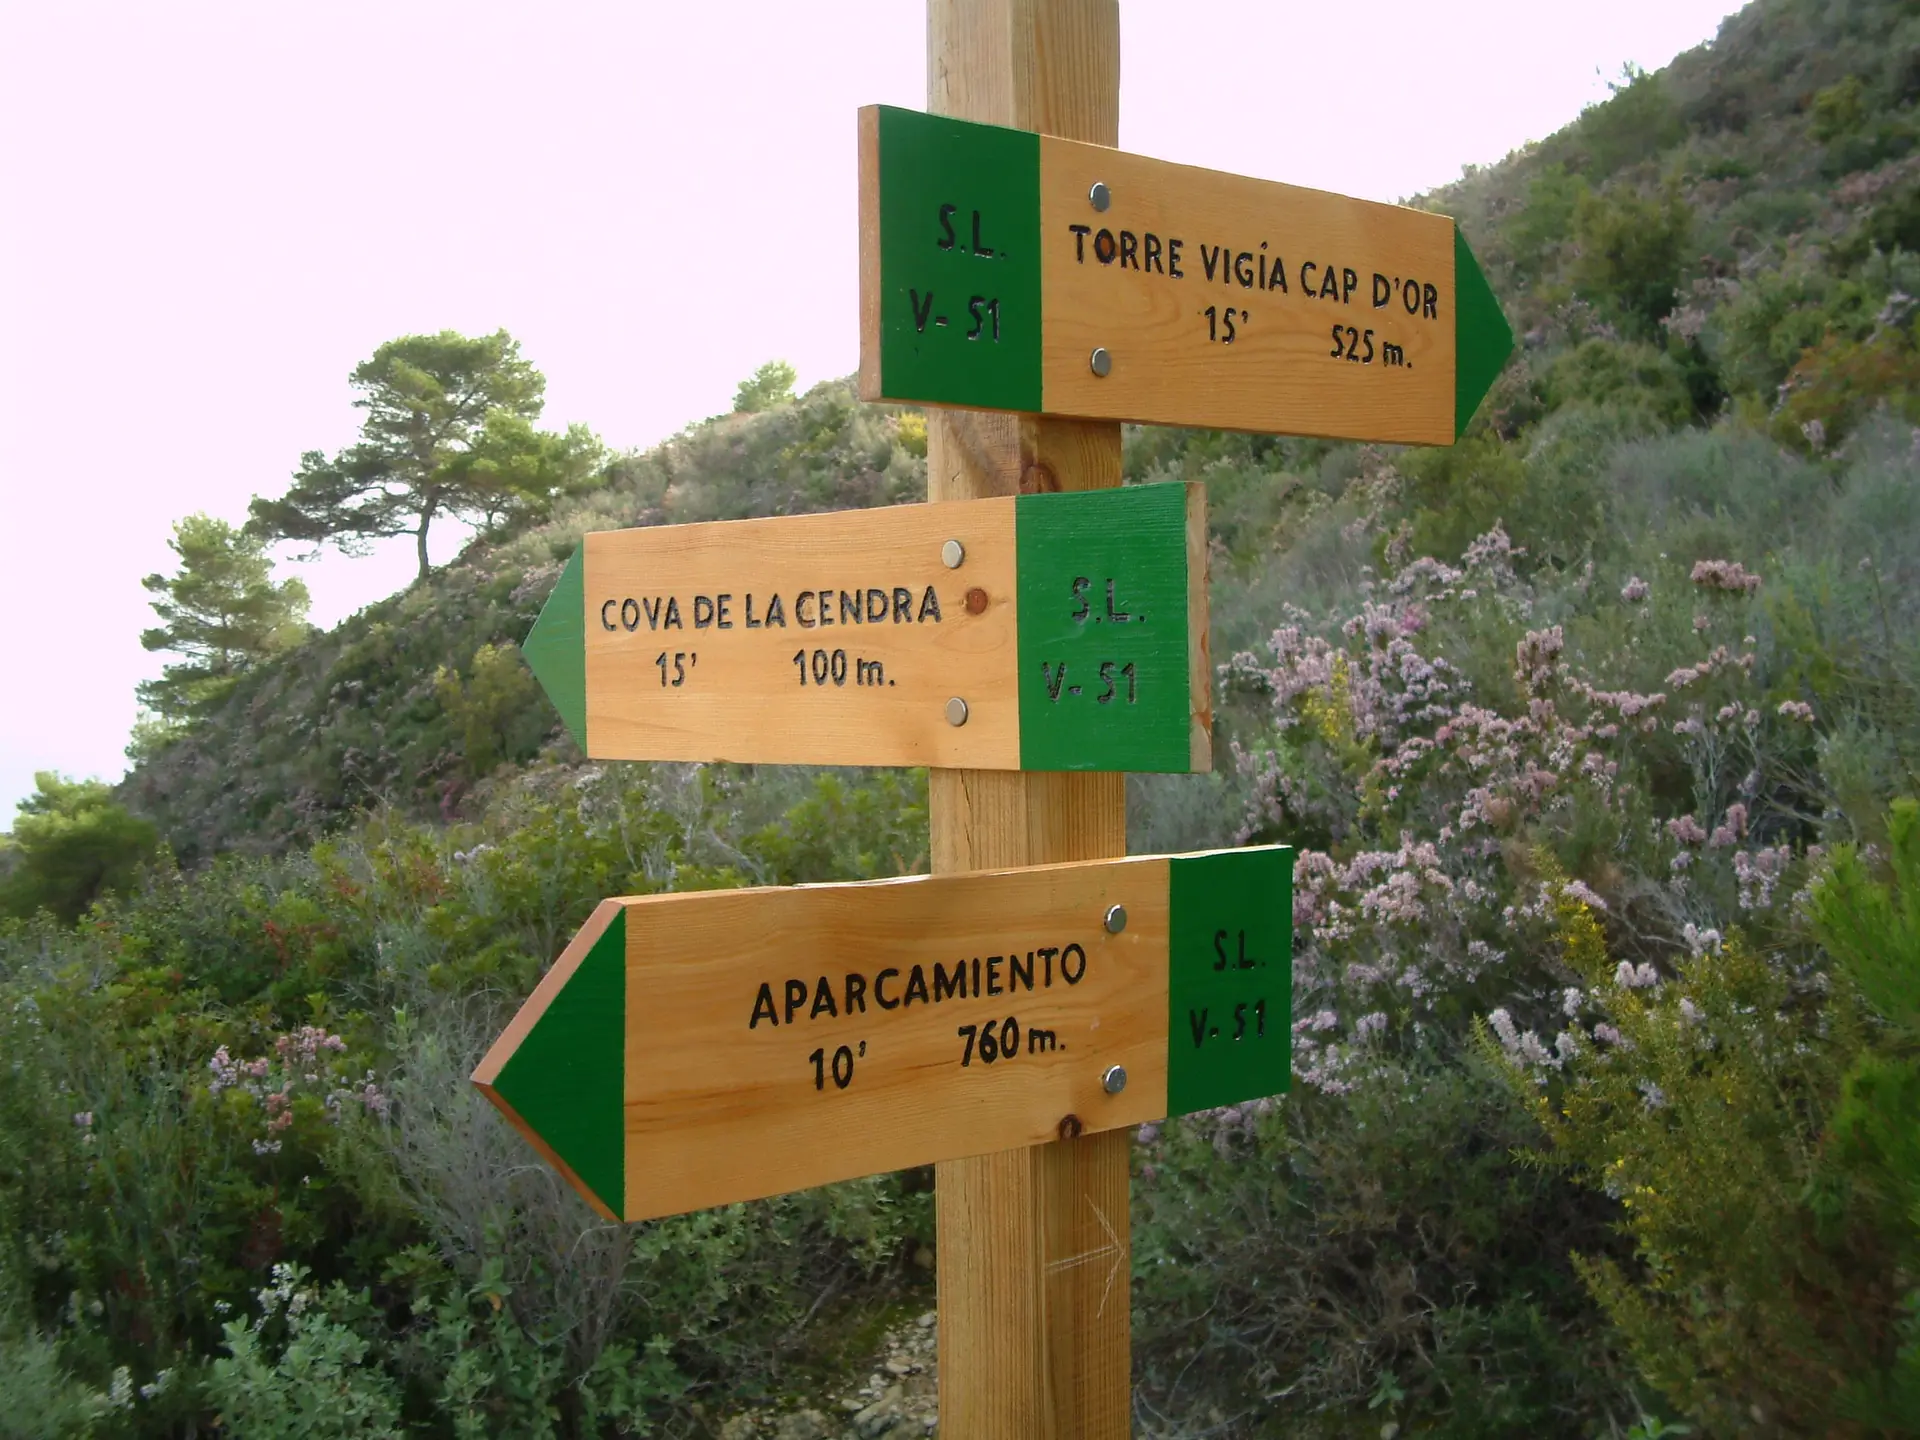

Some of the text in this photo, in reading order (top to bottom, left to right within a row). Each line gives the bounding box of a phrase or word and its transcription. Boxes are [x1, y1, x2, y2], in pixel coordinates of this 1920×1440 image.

[937, 203, 1006, 259] S.L.
[1068, 224, 1439, 321] TORRE VIGÍA CAP D'OR
[1330, 325, 1413, 369] 525 m.
[601, 585, 943, 632] COVA DE LA CENDRA
[1071, 577, 1146, 624] S.L.
[792, 648, 896, 688] 100 m.
[1213, 930, 1266, 972] S.L.
[749, 943, 1087, 1030] APARCAMIENTO
[957, 1016, 1066, 1068] 760 m.
